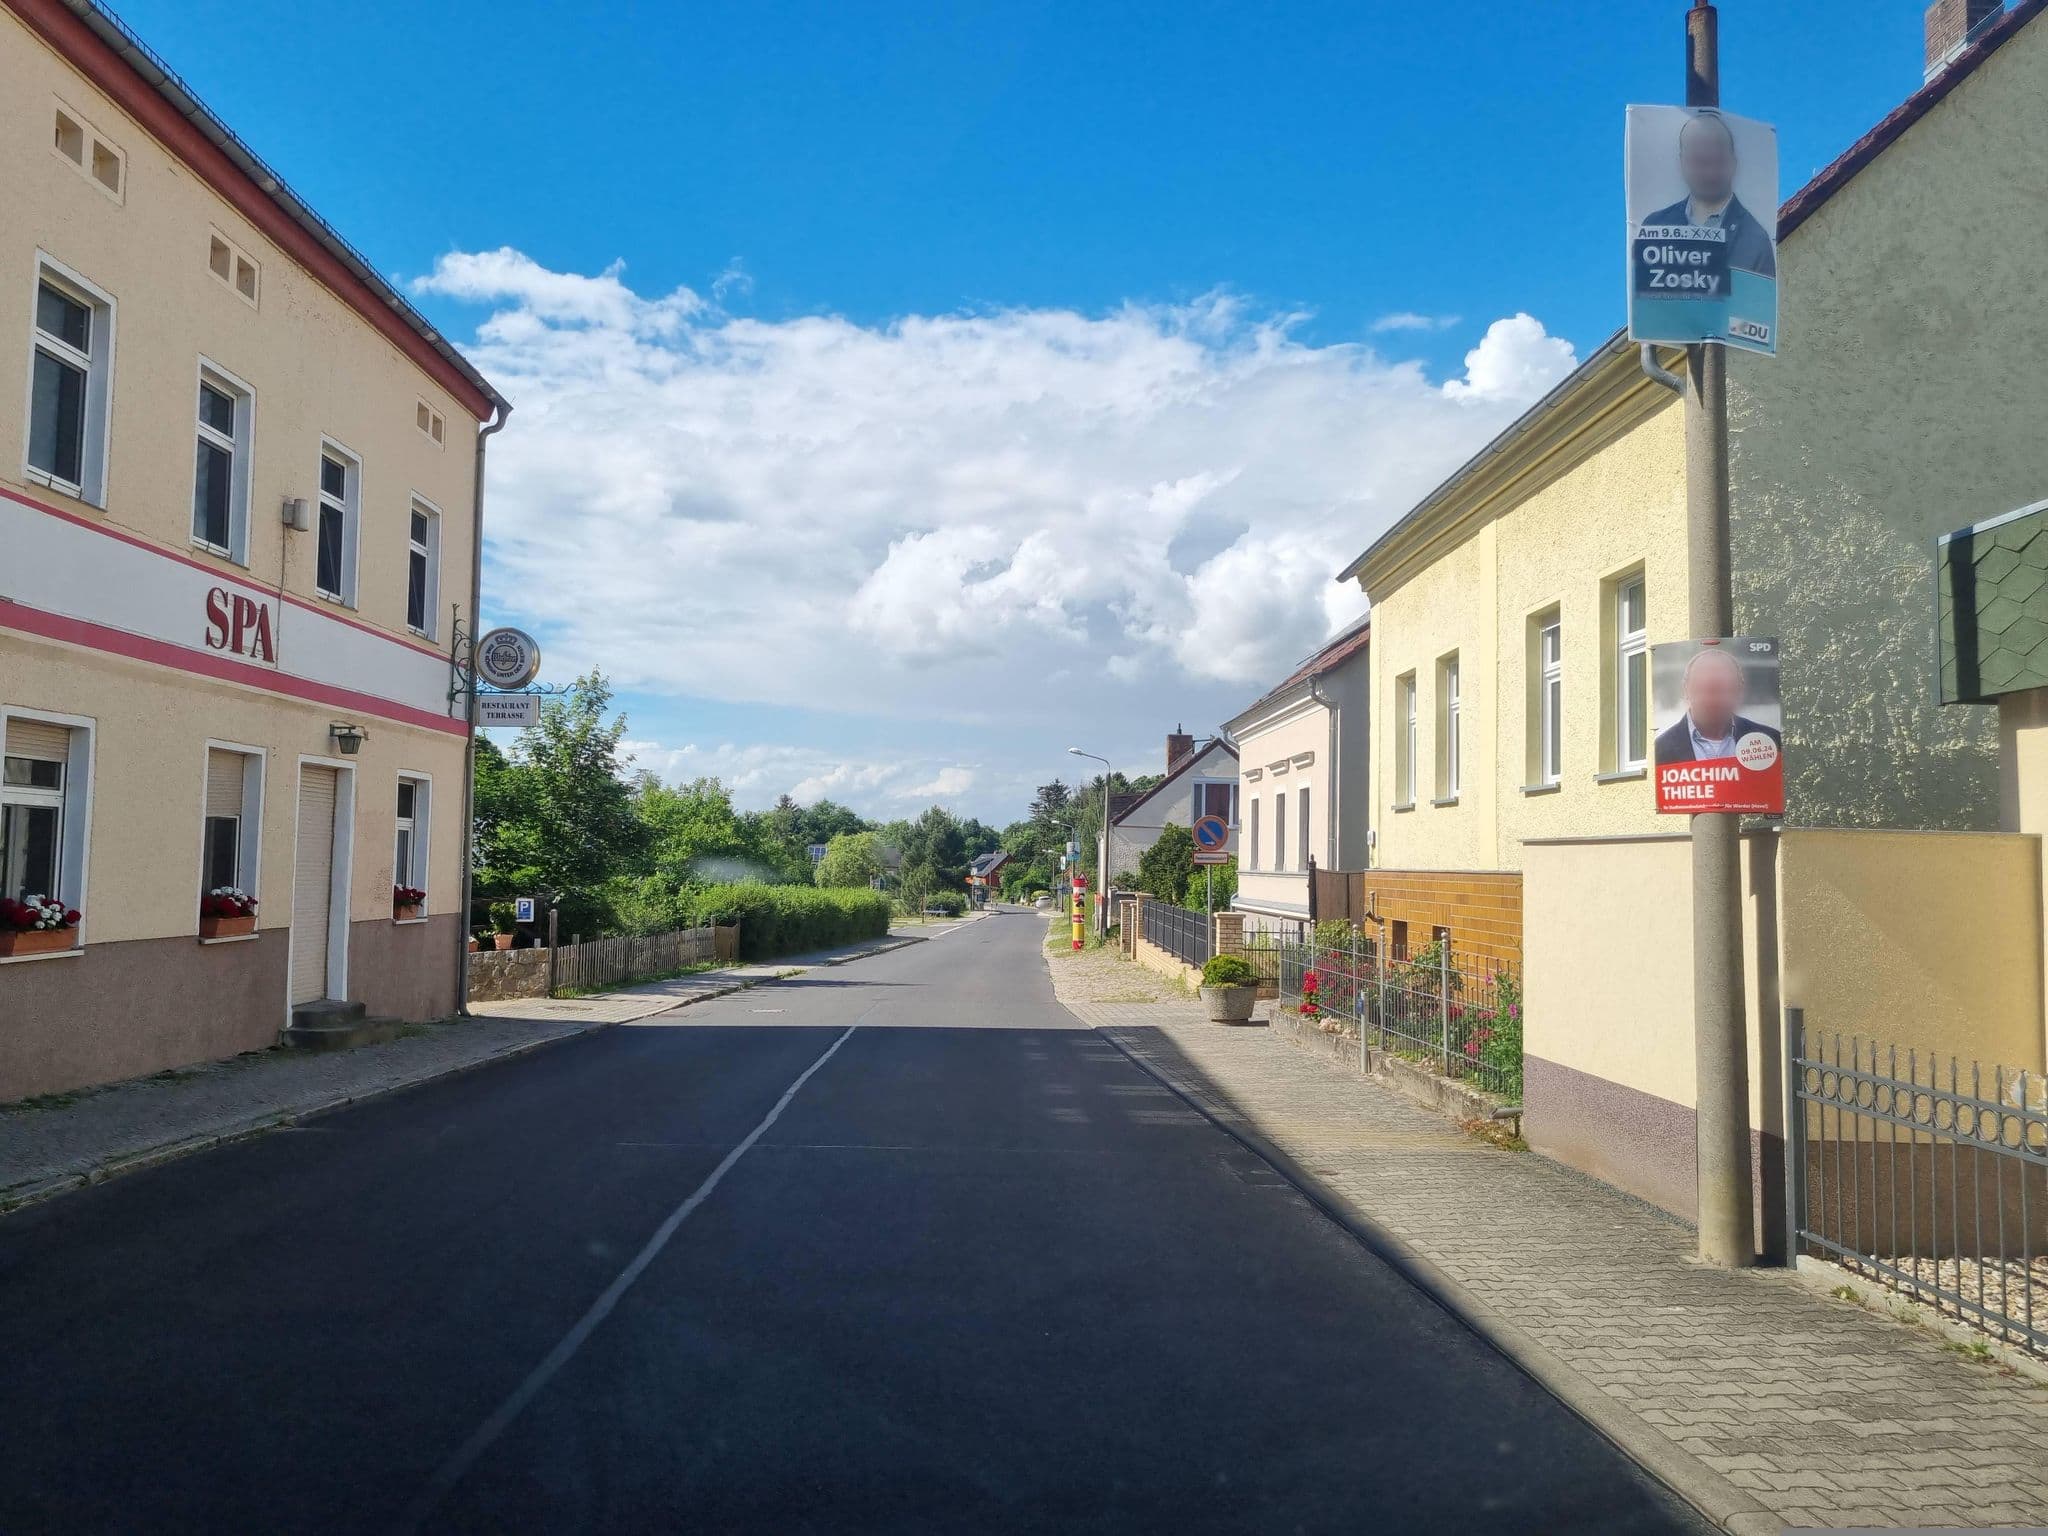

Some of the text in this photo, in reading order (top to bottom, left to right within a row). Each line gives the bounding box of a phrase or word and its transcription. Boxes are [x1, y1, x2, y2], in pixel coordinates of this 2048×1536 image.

[1639, 228, 1659, 238] Am
[1662, 228, 1688, 238] 9.6.:
[1642, 245, 1712, 265] Oliver
[1649, 269, 1720, 295] Zosky
[206, 587, 275, 663] SPA
[1749, 642, 1771, 652] SPD
[1661, 767, 1740, 784] JOACHIM
[1662, 785, 1715, 800] THIELE
[520, 902, 529, 911] P
